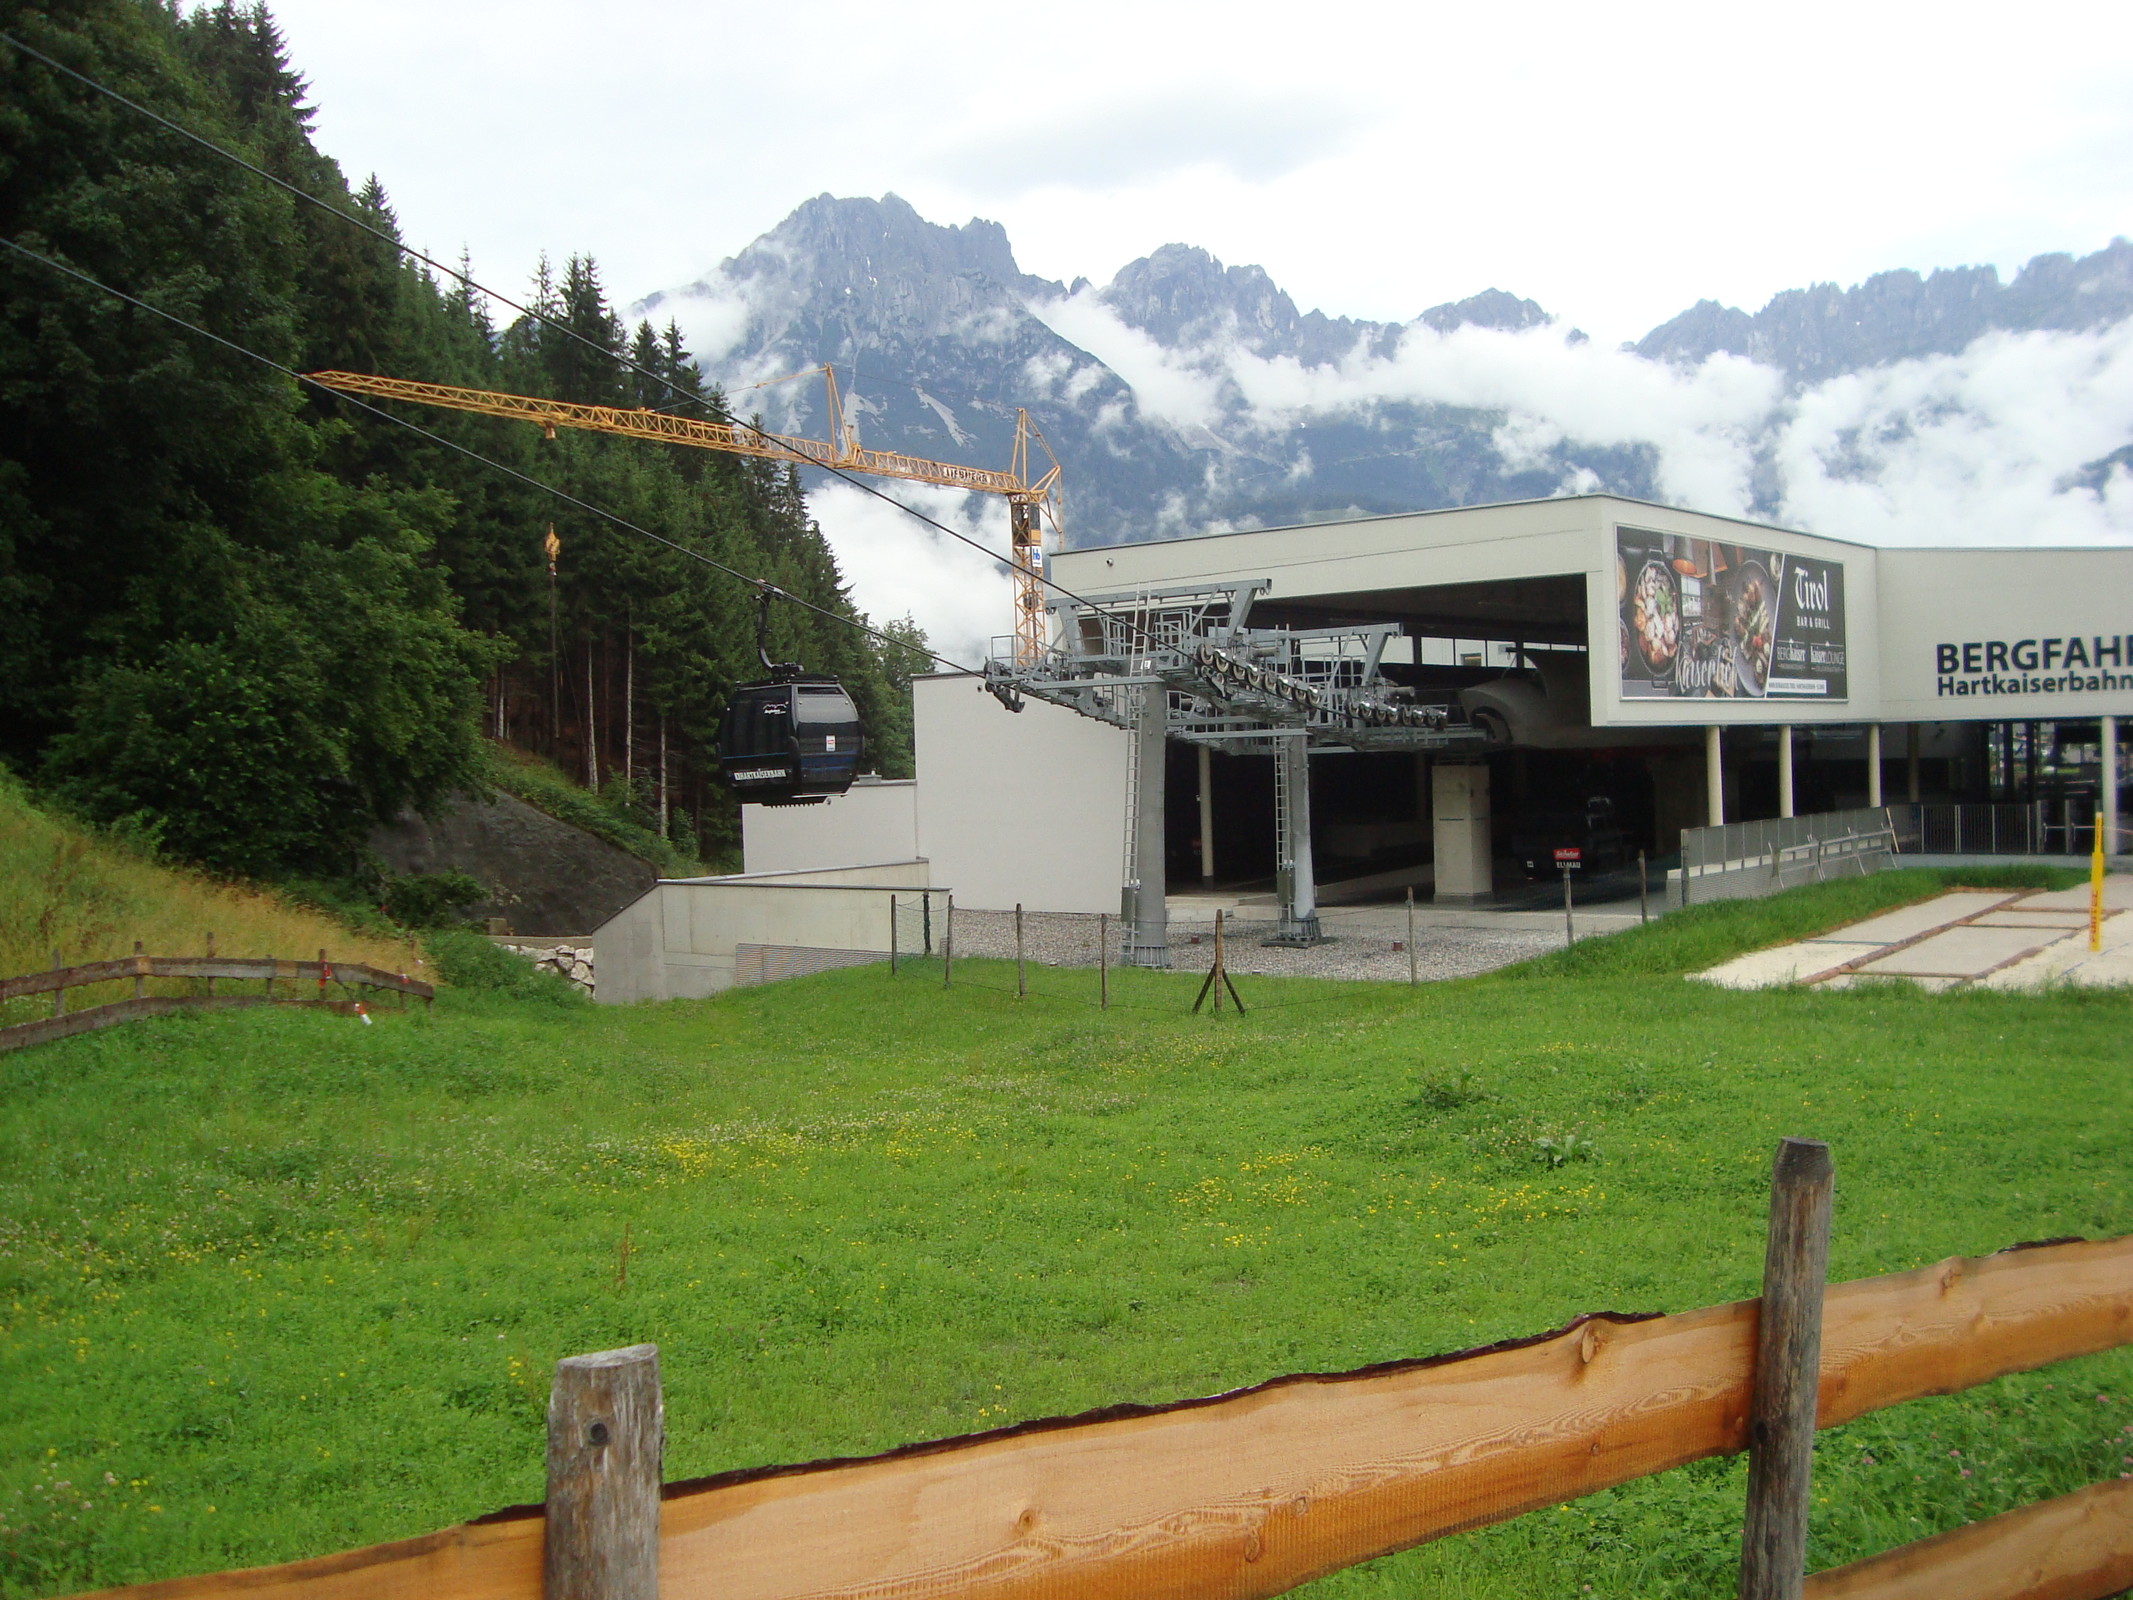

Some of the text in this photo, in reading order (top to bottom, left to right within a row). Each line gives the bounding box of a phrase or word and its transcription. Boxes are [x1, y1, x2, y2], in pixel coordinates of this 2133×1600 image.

[1794, 566, 1829, 612] Tirol
[1796, 615, 1808, 628] BAR
[1814, 617, 1831, 630] GRILL
[1936, 634, 2133, 674] BERGFAH
[1937, 669, 2133, 696] Hartkaiserbahn
